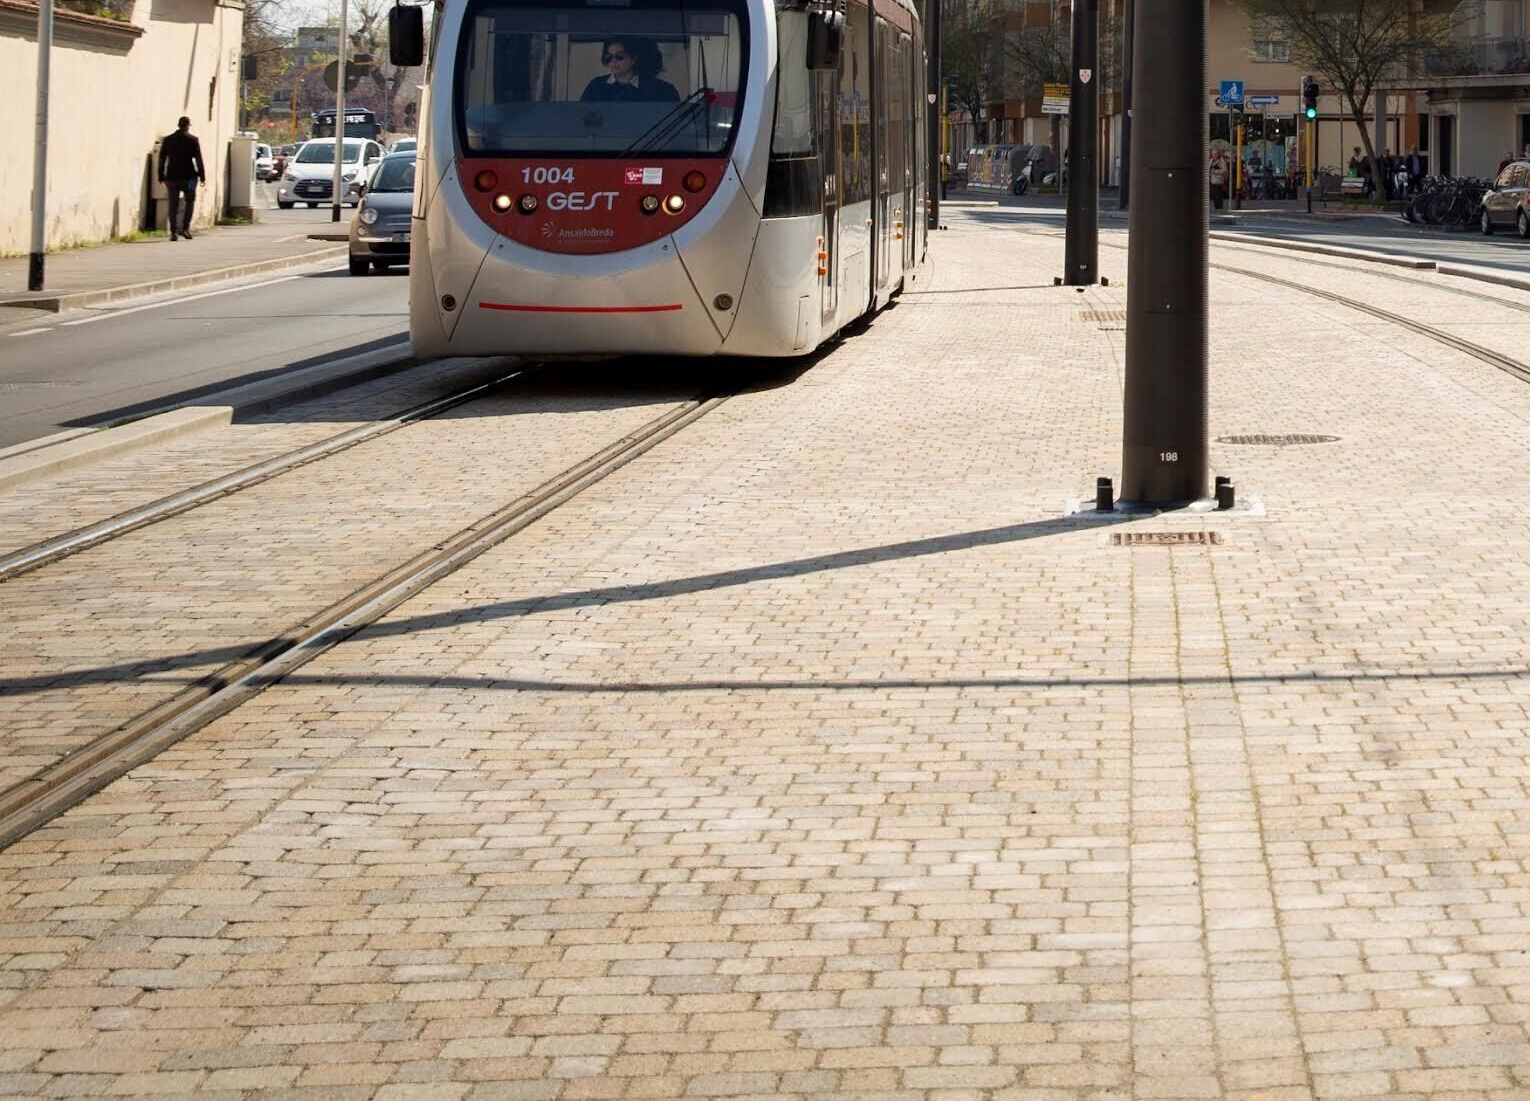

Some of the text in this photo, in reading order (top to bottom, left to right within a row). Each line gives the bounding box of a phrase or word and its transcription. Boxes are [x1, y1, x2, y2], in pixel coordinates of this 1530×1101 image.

[521, 166, 575, 184] 1004
[546, 191, 620, 211] GEST
[559, 227, 614, 237] AnsaldoBreda
[1159, 452, 1178, 462] 198
